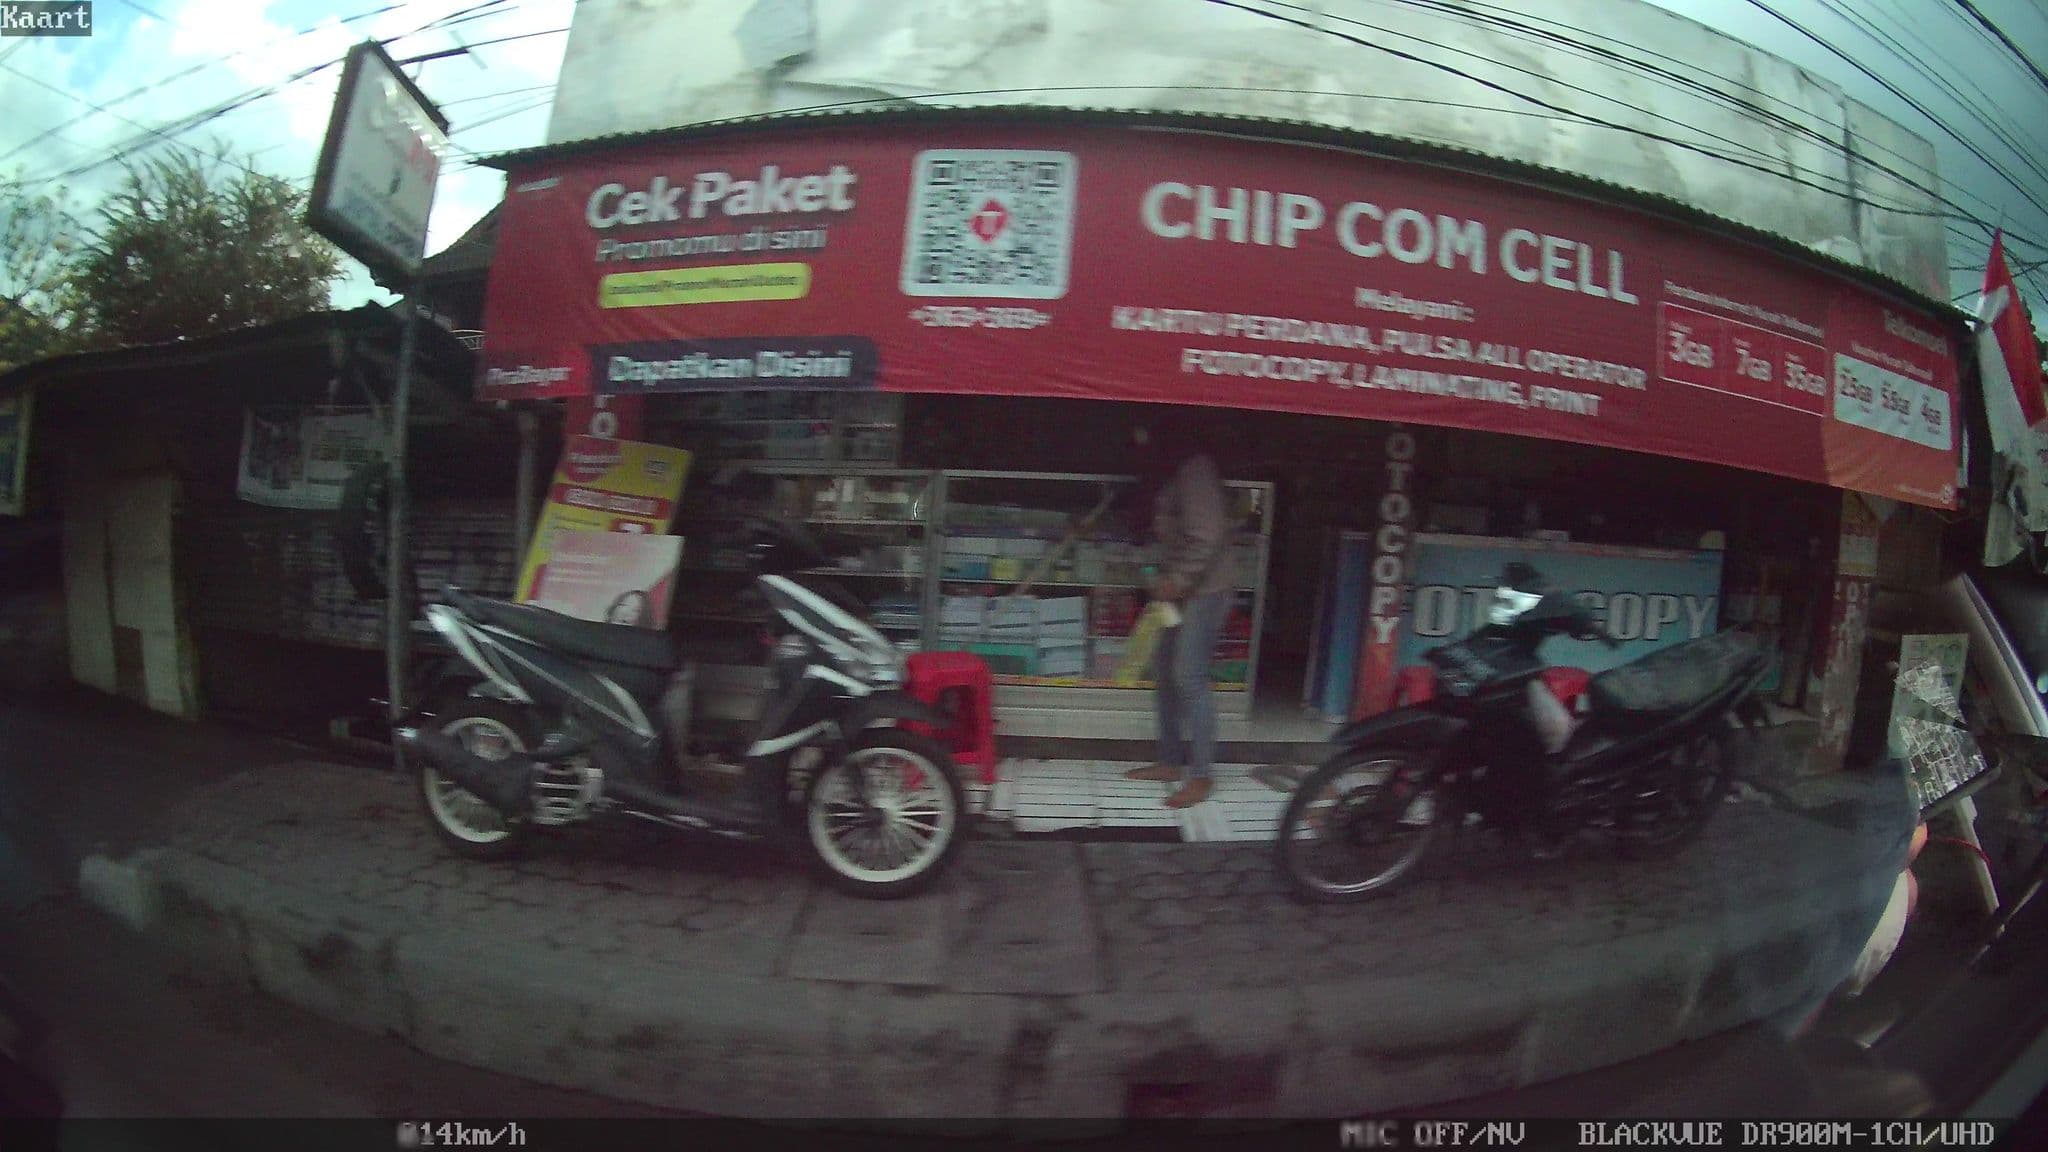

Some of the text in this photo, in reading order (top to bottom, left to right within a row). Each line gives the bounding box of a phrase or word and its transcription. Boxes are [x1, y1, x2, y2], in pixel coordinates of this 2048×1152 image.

[585, 164, 857, 229] Cek Paket
[1142, 181, 1639, 305] CHIP COM CELL
[608, 349, 853, 386] Dapatkan Disini
[1111, 305, 1222, 336] KARTU
[1383, 328, 1473, 363] PULSA
[1475, 341, 1526, 371] ALL
[1525, 349, 1647, 391] OPERATOR
[1529, 385, 1602, 417] PRINT
